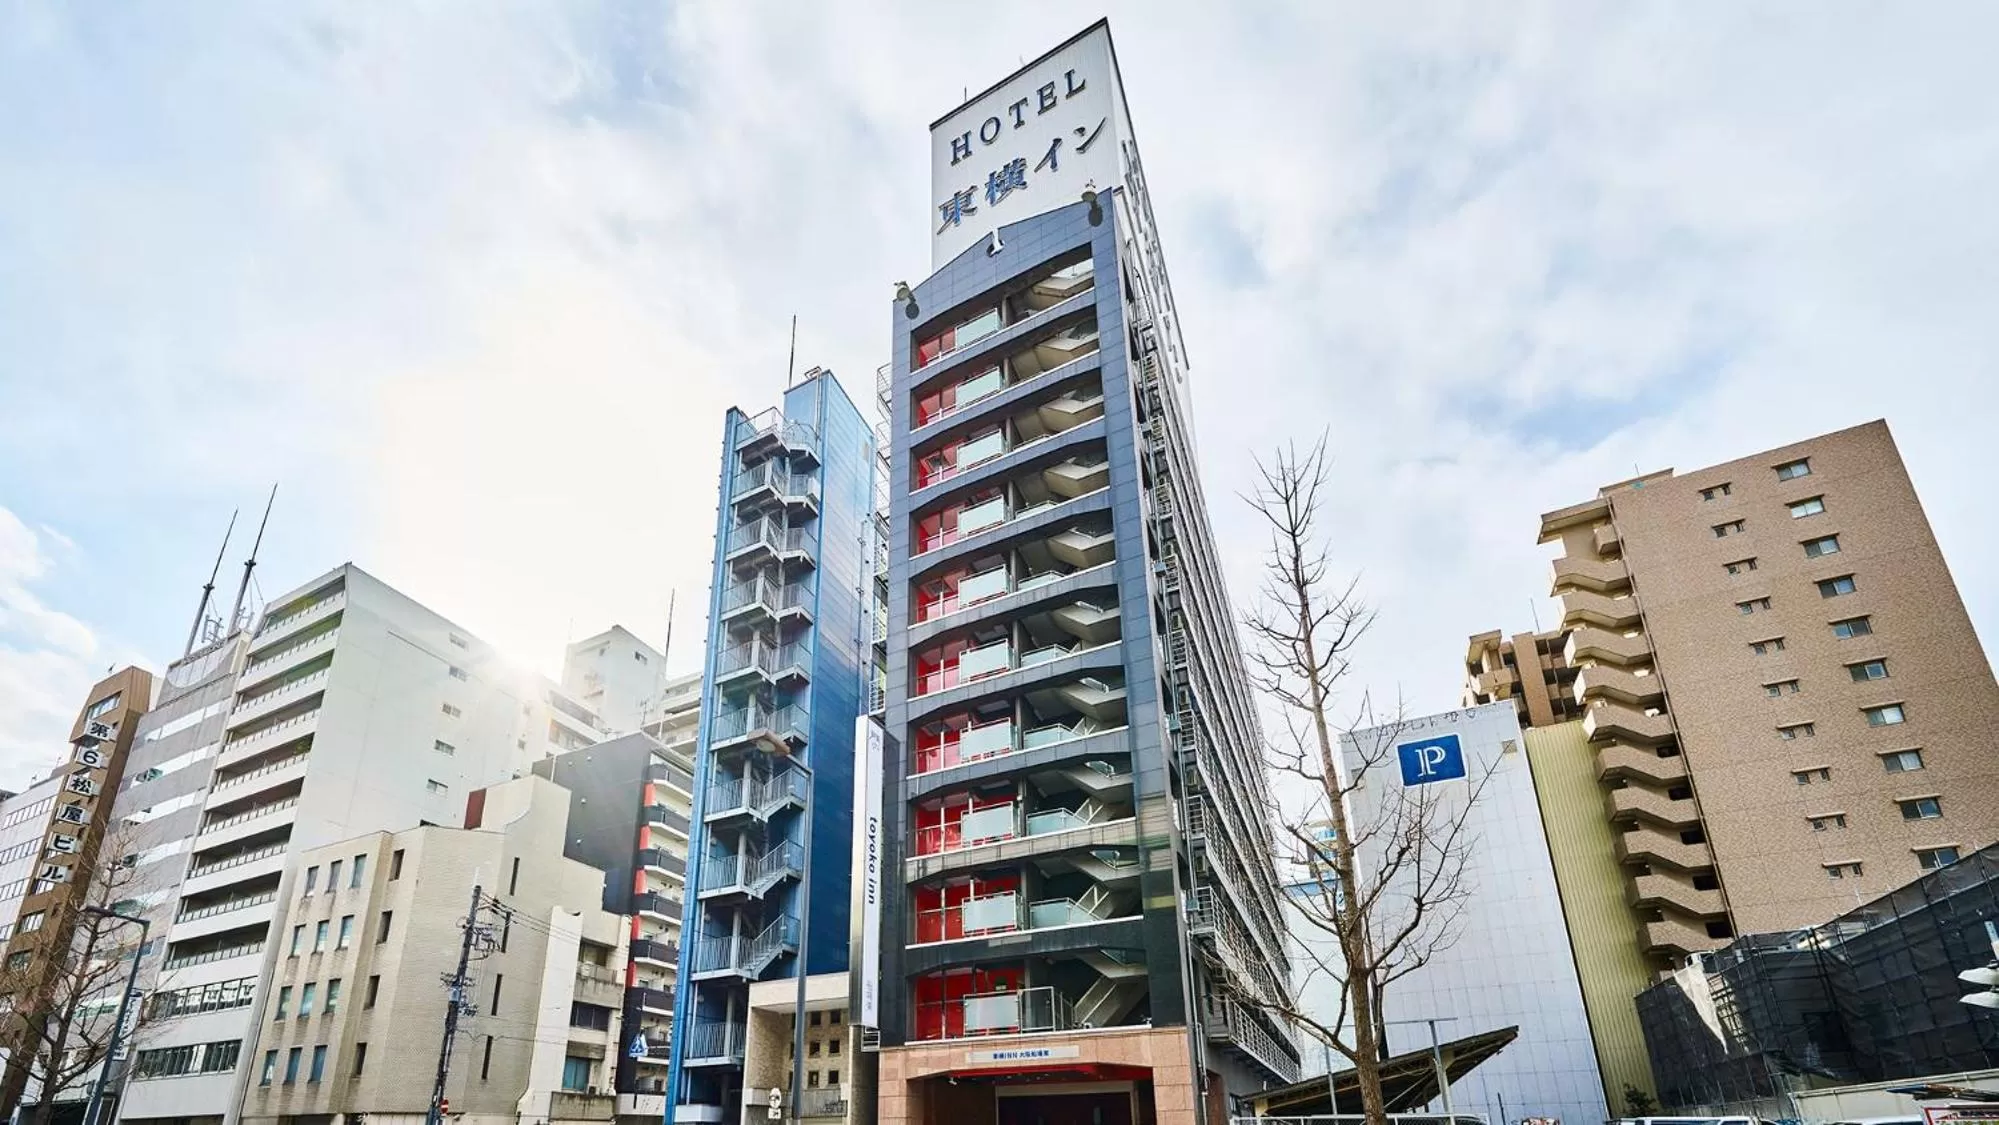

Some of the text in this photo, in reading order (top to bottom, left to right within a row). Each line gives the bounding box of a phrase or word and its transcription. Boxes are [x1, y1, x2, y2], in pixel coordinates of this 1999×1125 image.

[951, 69, 1086, 166] HOTEL
[937, 117, 1106, 235] 東横イン
[1414, 745, 1446, 777] P
[868, 817, 877, 904] toyoko inn
